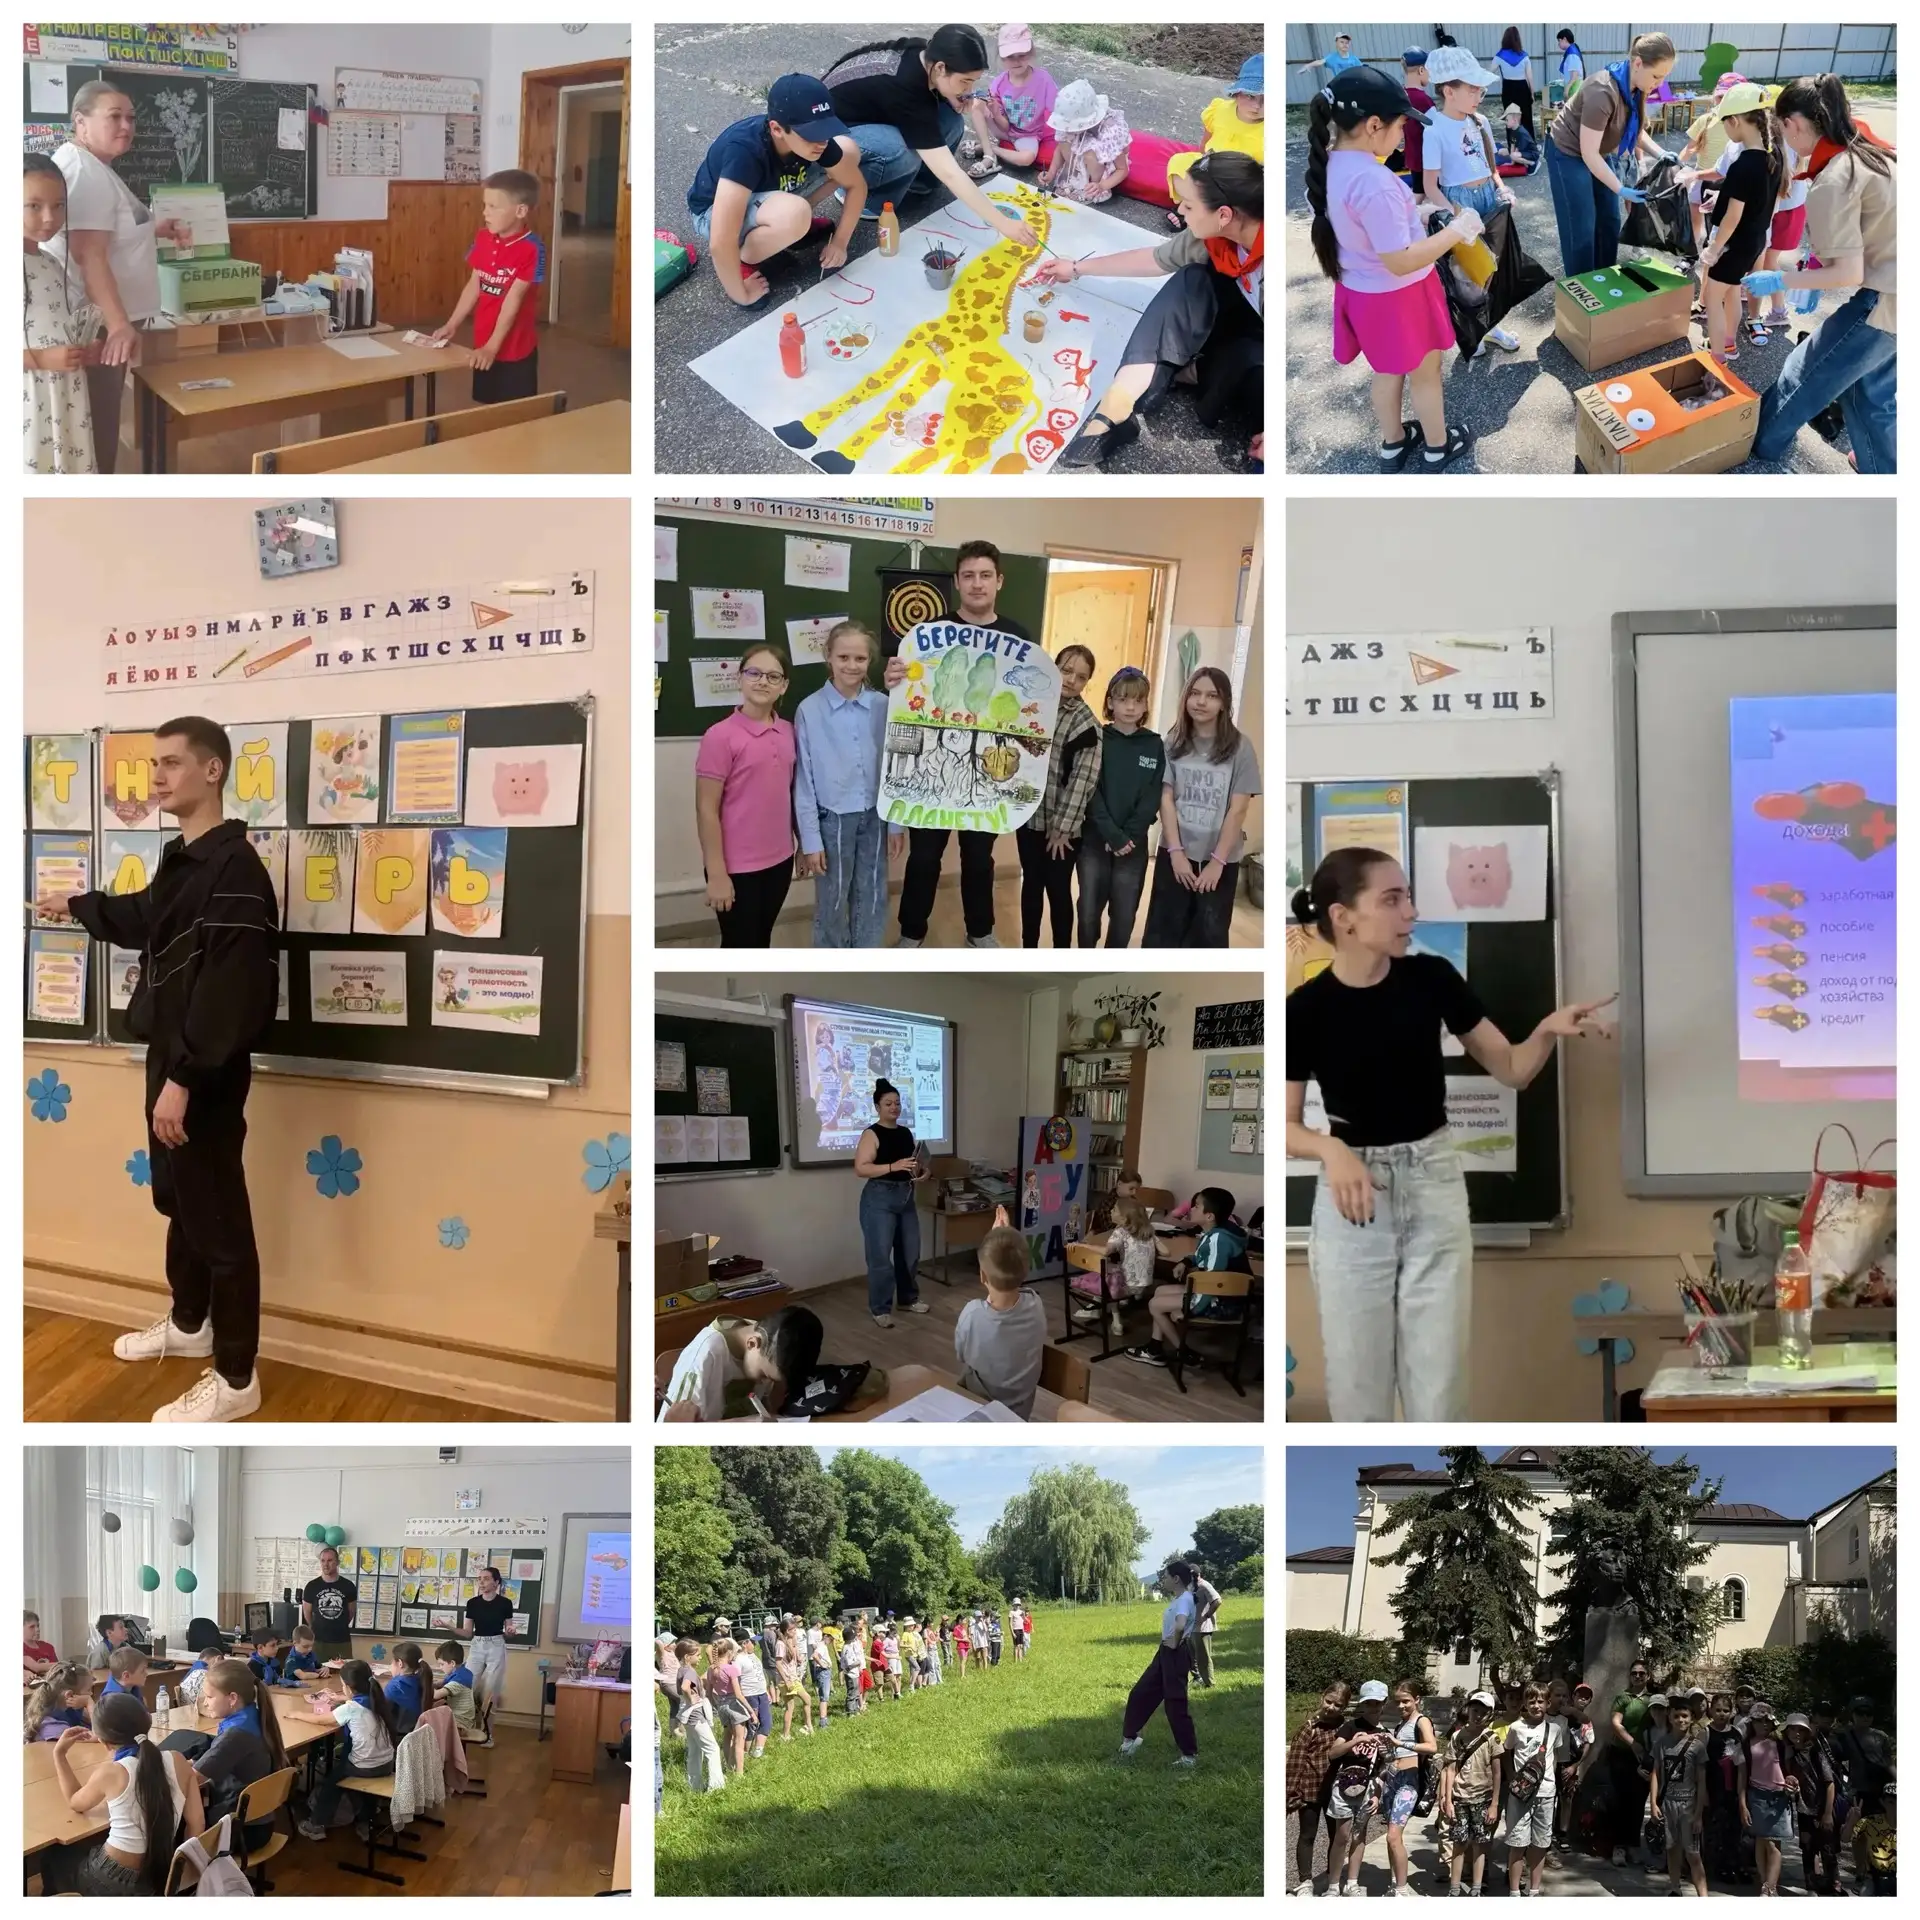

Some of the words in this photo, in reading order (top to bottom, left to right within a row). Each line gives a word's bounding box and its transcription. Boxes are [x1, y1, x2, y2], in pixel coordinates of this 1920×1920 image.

[811, 102, 831, 115] FILA
[181, 265, 260, 283] СБЕРБАНК
[1581, 388, 1631, 443] ПЛАСТИК
[733, 499, 741, 510] 9
[750, 501, 764, 513] 10
[770, 504, 783, 515] 11
[788, 506, 802, 518] 12
[806, 508, 820, 520] 13
[824, 511, 837, 522] 14
[841, 513, 855, 524] 15
[859, 515, 871, 526] 16
[875, 517, 887, 528] 17
[891, 520, 903, 530] 18
[907, 521, 919, 532] 19
[886, 799, 1010, 830] ПЛАНЕТУ!
[1820, 889, 1895, 903] заработная
[1820, 921, 1876, 933] пособие
[1820, 953, 1867, 963] пенсия
[468, 966, 528, 976] Финансовая
[467, 978, 528, 987] грамотность
[1819, 976, 1858, 988] доход
[1860, 977, 1875, 986] от
[1878, 976, 1897, 988] по
[499, 990, 535, 1000] модно!
[1820, 990, 1885, 1003] хозяйства
[1820, 1014, 1866, 1026] кредит
